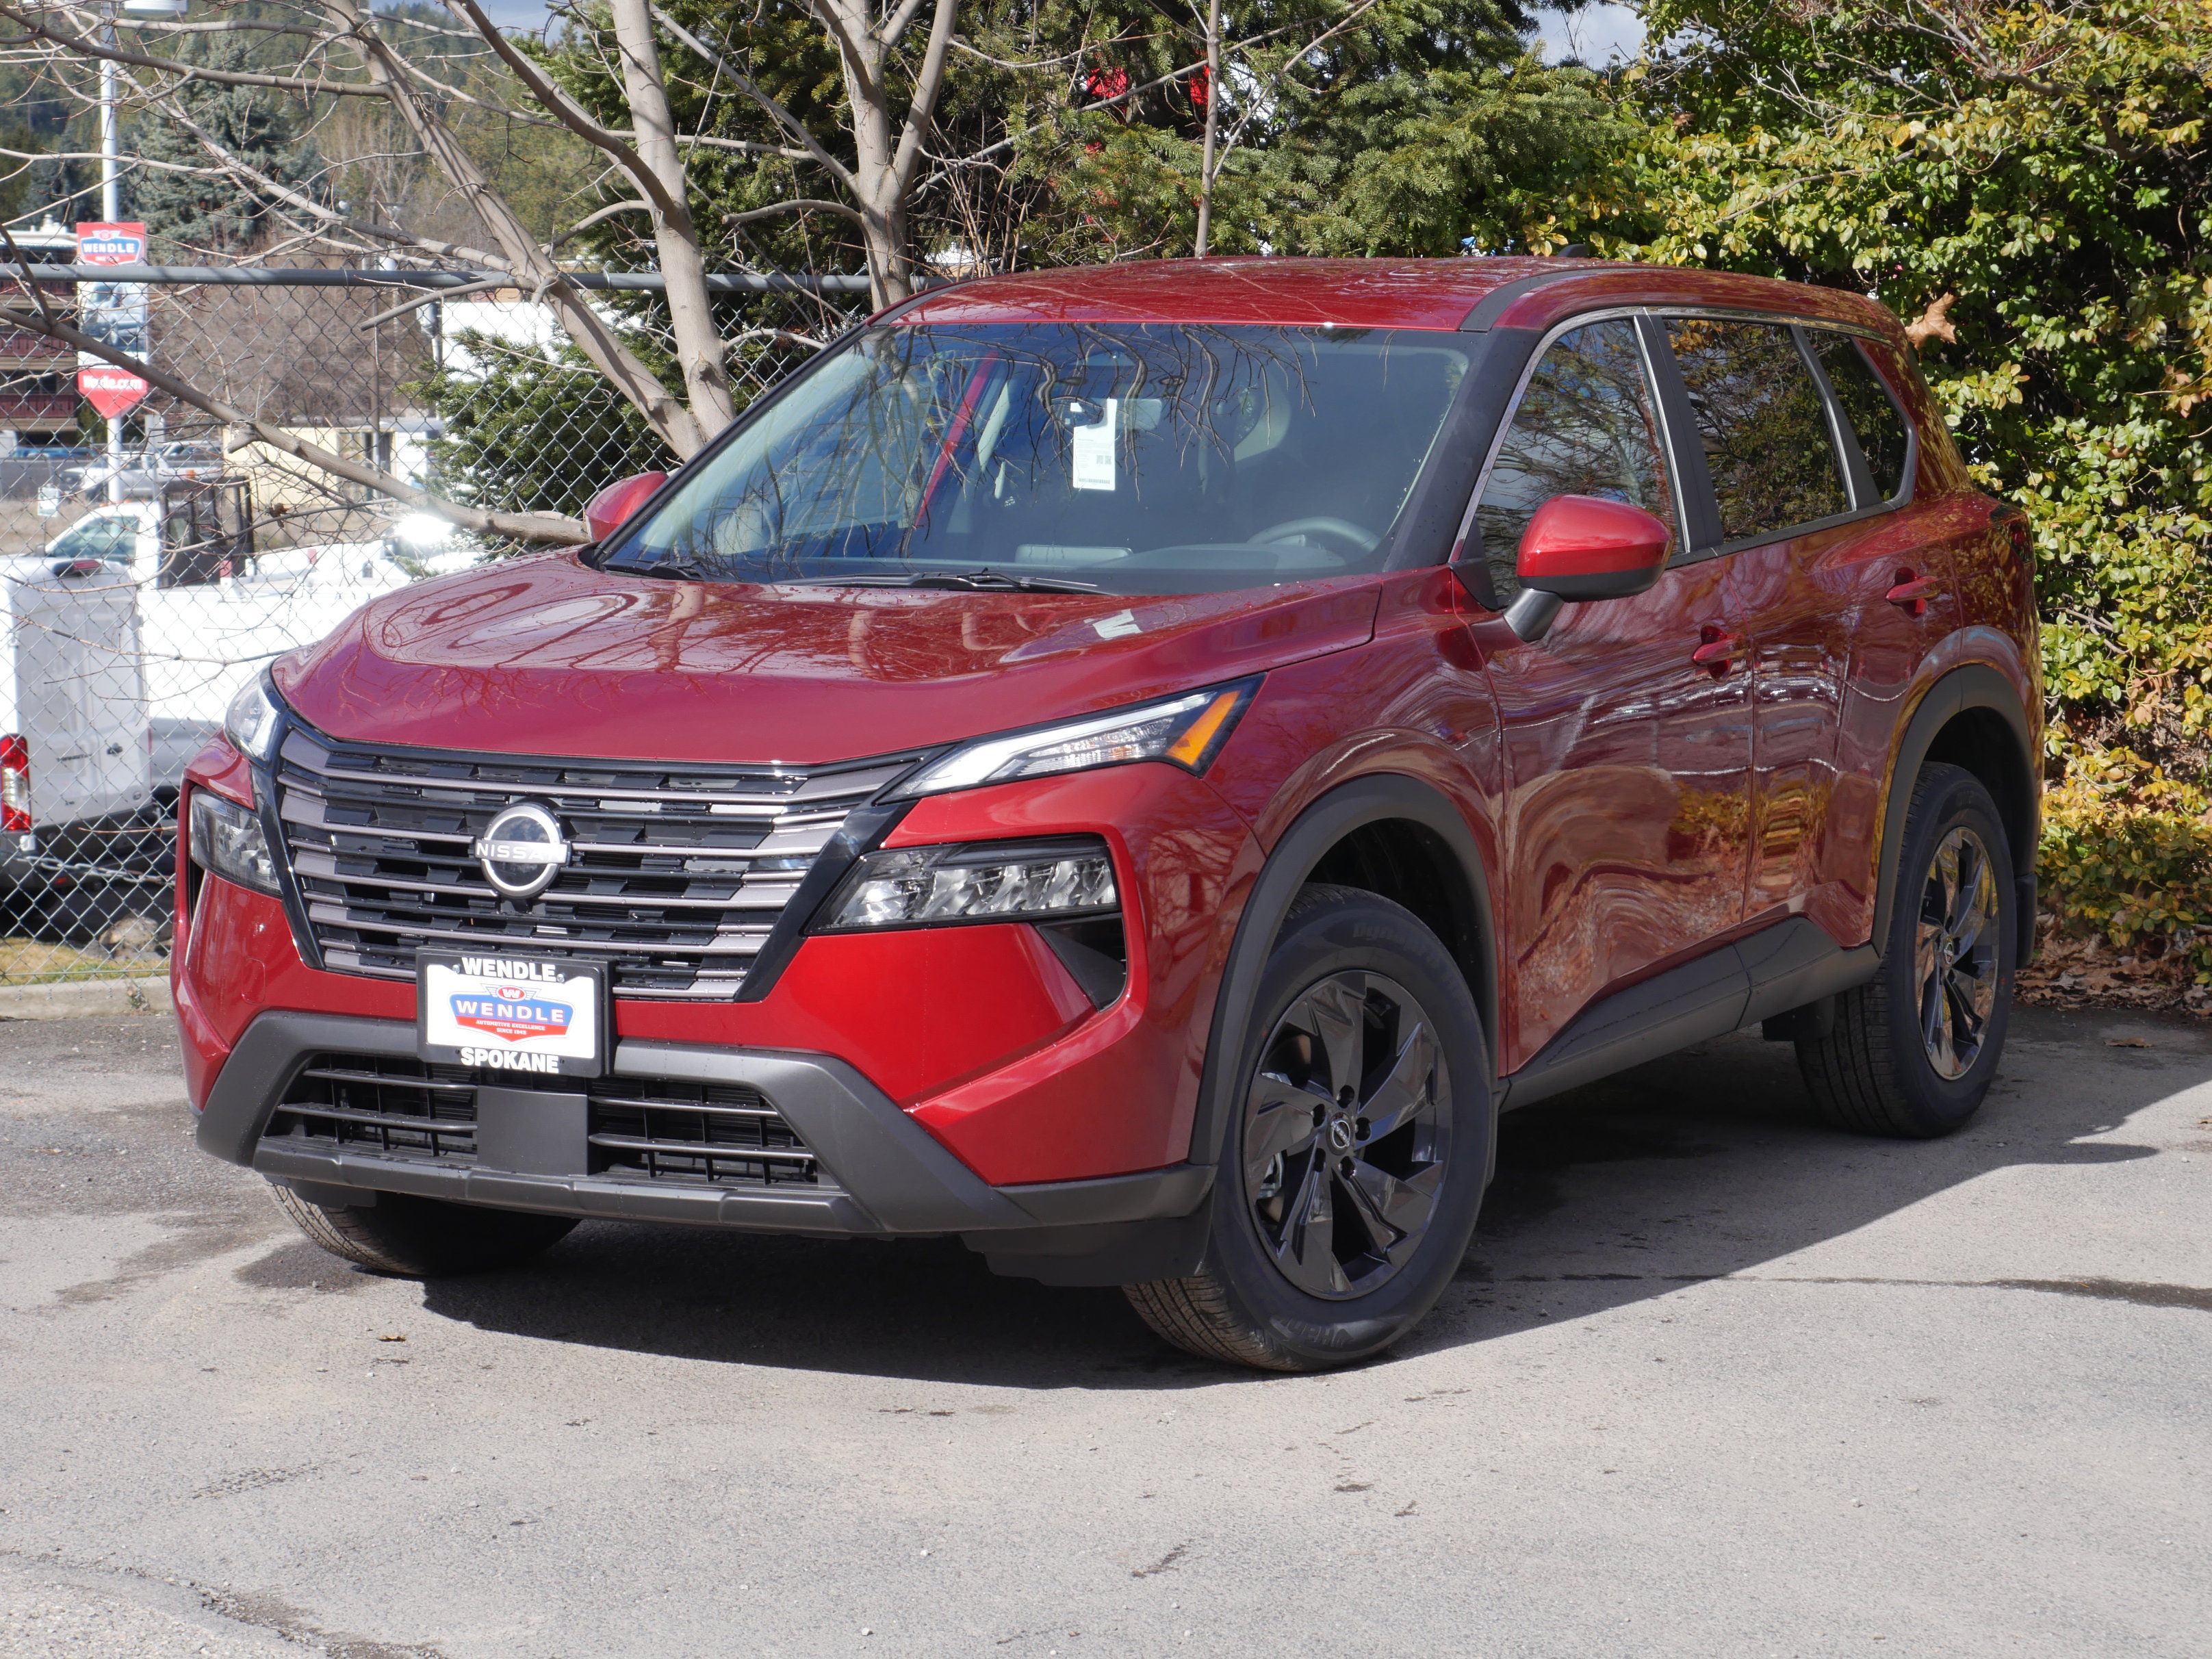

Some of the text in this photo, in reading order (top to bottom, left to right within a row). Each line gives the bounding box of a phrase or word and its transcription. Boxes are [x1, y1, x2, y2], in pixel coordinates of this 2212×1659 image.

[83, 243, 135, 253] WENDLE
[461, 957, 556, 981] WENDLE
[456, 1000, 564, 1023] WENDLE
[476, 1020, 546, 1031] AUTOMOTIVE EXCELLENCE
[461, 1046, 559, 1074] SPOKANE
